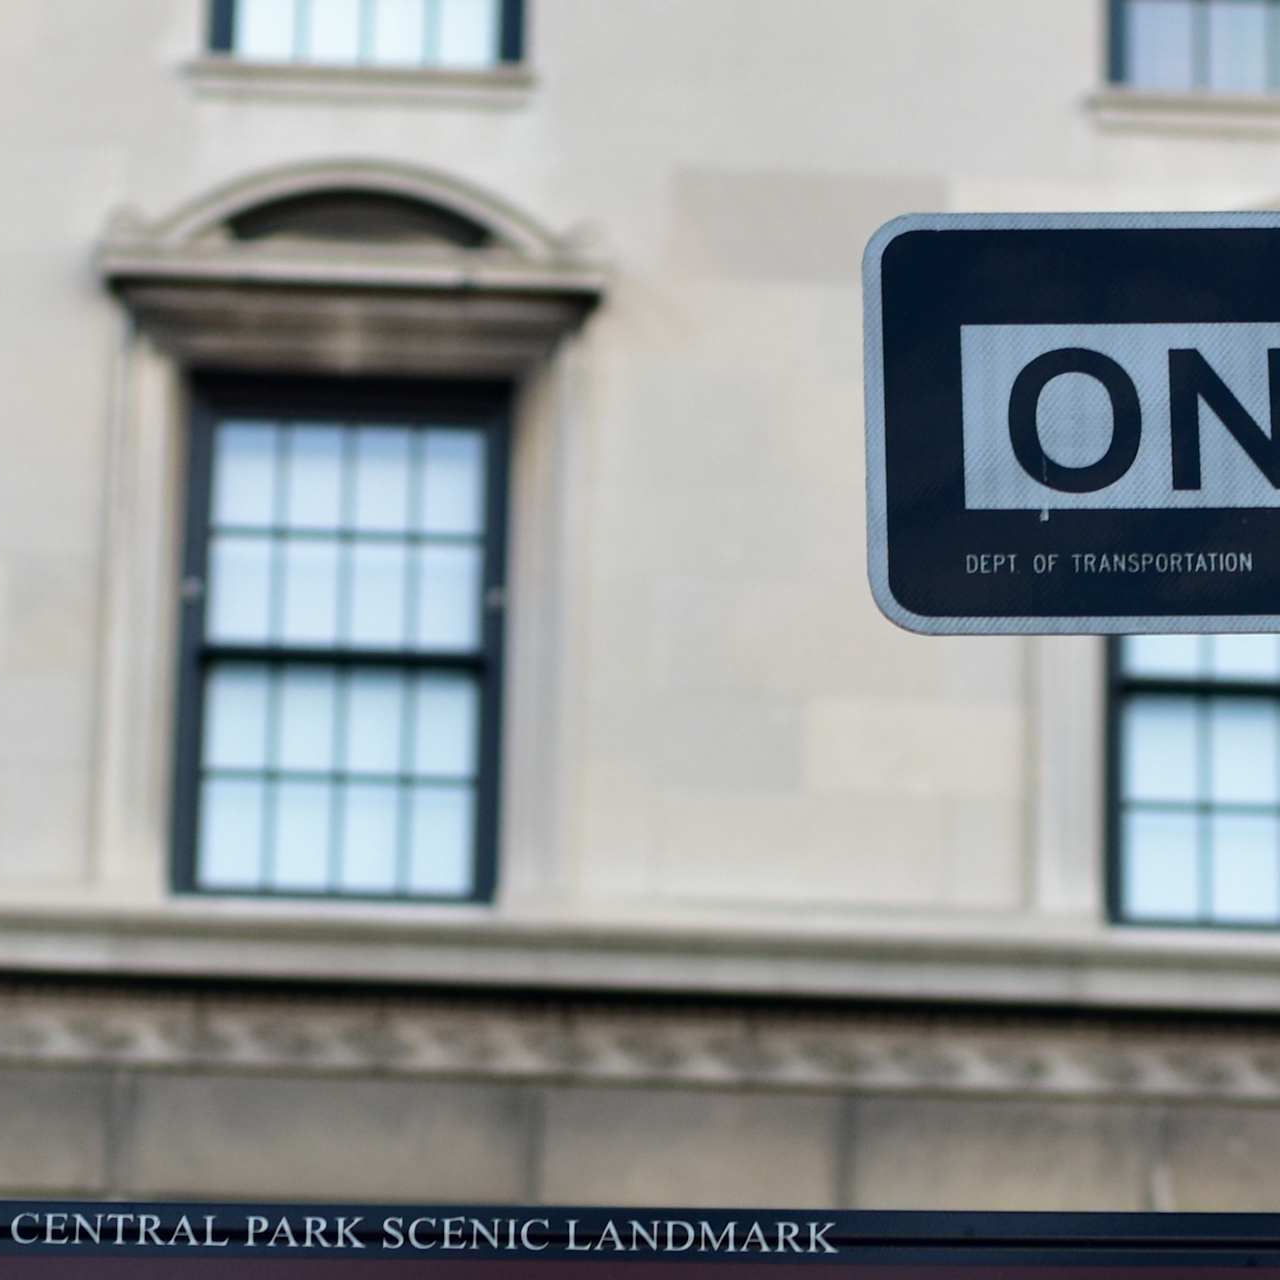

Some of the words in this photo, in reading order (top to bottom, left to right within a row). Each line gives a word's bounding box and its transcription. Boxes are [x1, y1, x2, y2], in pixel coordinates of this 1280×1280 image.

[1033, 553, 1059, 574] OF
[1071, 552, 1253, 573] TRANSPORTATION
[10, 1212, 229, 1247] CENTRAL
[244, 1215, 366, 1249] PARK
[382, 1216, 549, 1251] SCENIC
[565, 1219, 839, 1254] LANDMARK
